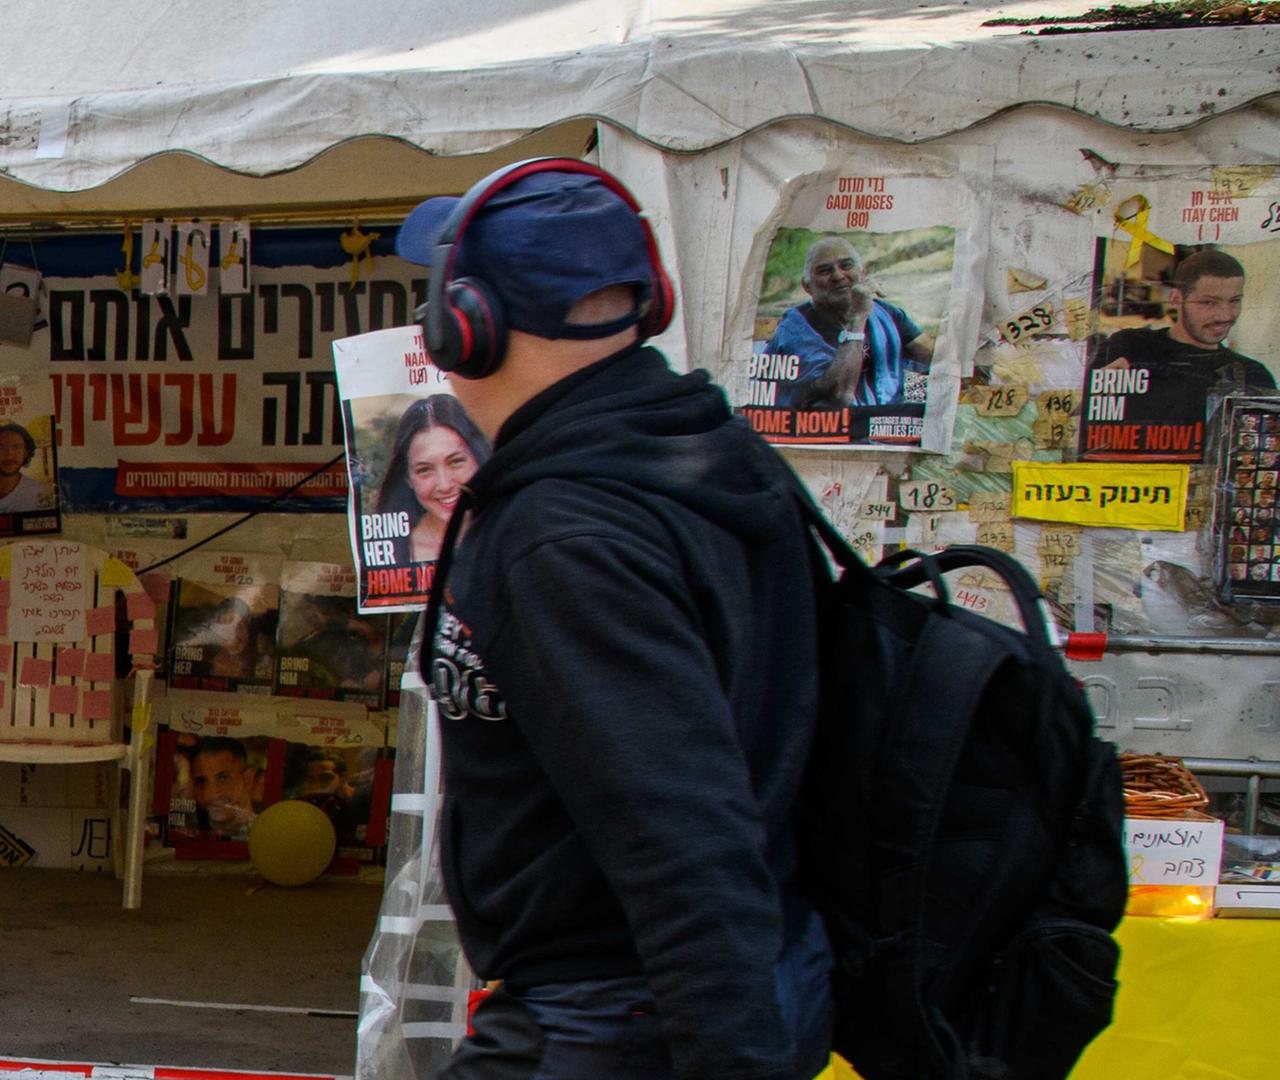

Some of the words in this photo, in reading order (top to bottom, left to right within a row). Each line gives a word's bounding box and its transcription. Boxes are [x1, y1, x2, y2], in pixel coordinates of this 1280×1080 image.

[866, 178, 885, 193] גדי
[826, 194, 851, 212] GADI
[853, 194, 894, 212] MOSES
[845, 211, 870, 230] (80)
[1182, 208, 1205, 223] ITAY
[1207, 207, 1239, 222] CHEN
[50, 286, 194, 361] אותם
[1007, 306, 1053, 340] 328
[749, 354, 801, 382] BRING
[1091, 369, 1151, 395] BRING
[49, 372, 237, 447] עכשיו!
[986, 389, 1016, 411] 128
[1088, 396, 1125, 421] HIM
[1087, 425, 1140, 450] HOME
[1146, 421, 1203, 450] NOW!
[1025, 483, 1092, 503] בעזה
[1099, 484, 1171, 509] תינוק
[865, 504, 891, 516] 344
[362, 511, 410, 540] BRING
[364, 541, 396, 566] HER
[368, 567, 414, 595] HOME
[956, 590, 988, 610] 443
[174, 647, 203, 662] BRING
[280, 657, 309, 672] BRING
[174, 661, 191, 675] HER
[280, 671, 298, 685] HIM
